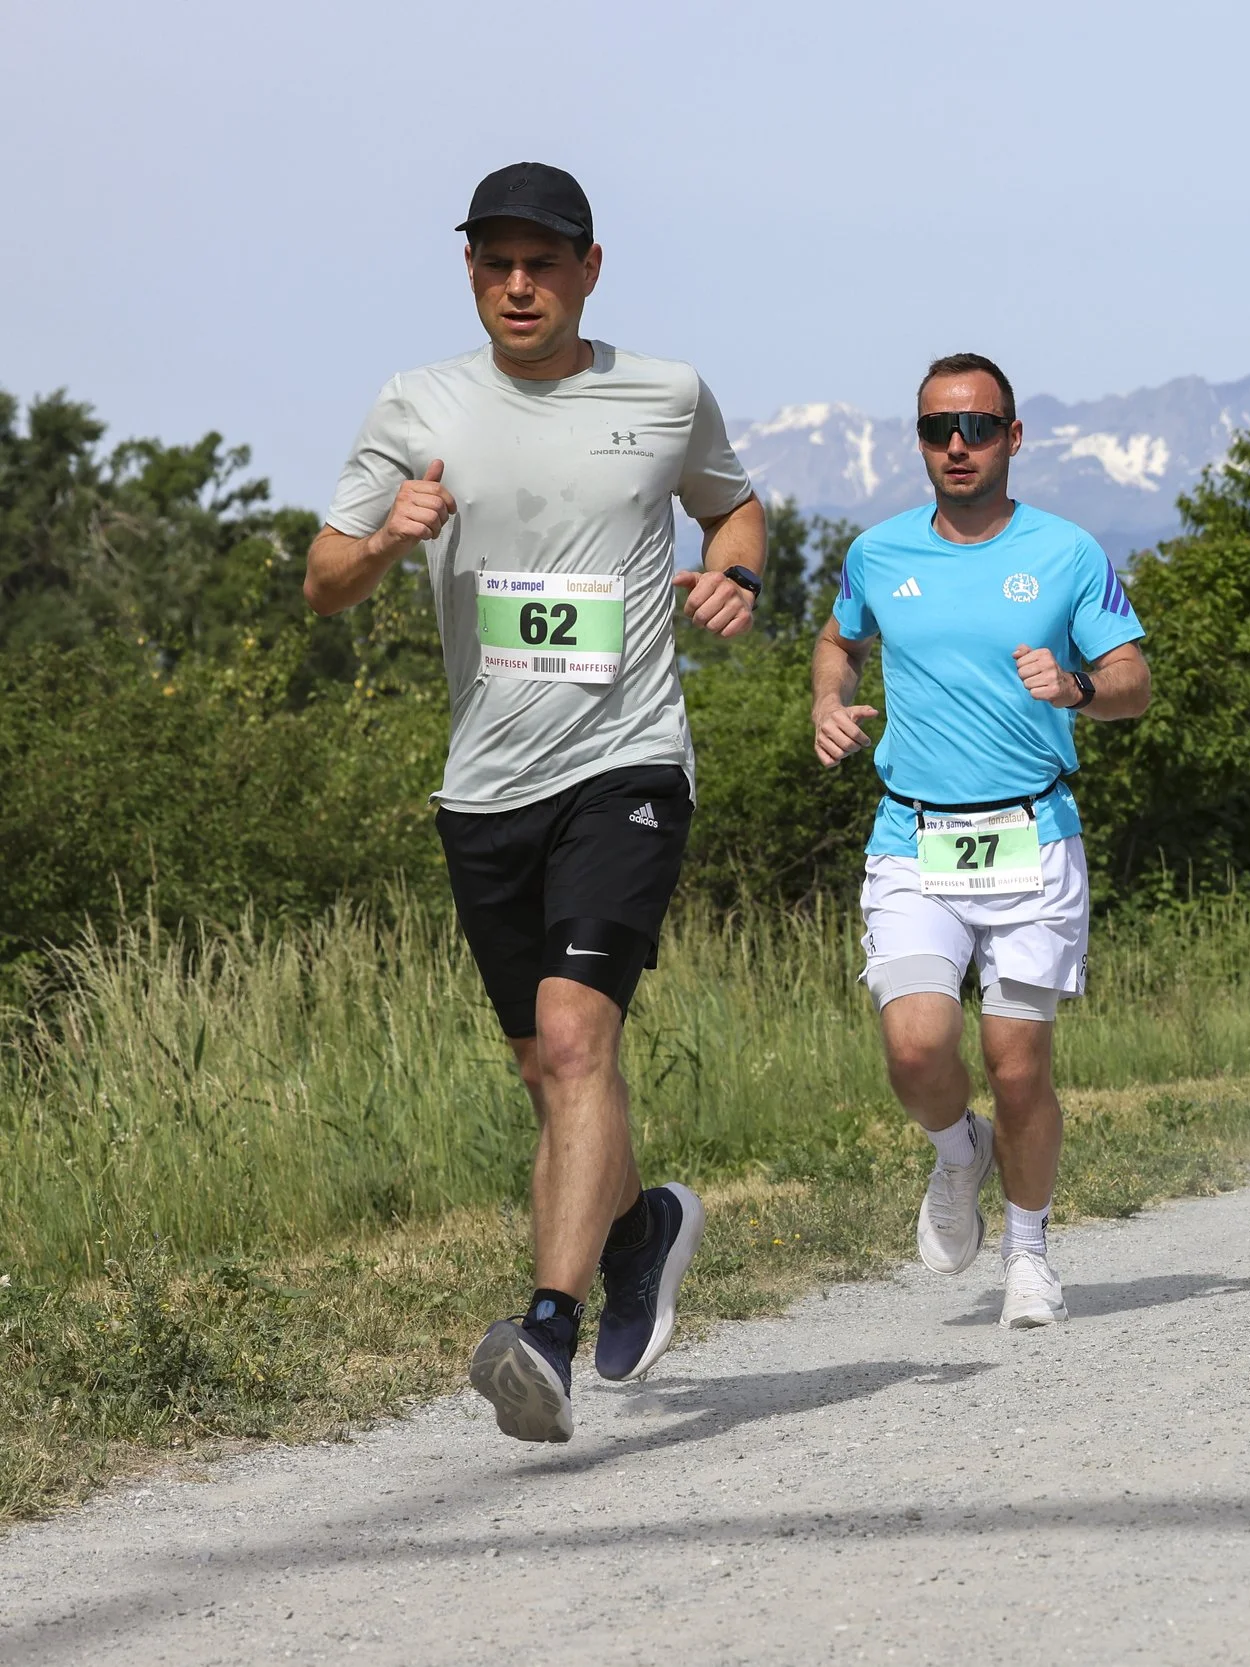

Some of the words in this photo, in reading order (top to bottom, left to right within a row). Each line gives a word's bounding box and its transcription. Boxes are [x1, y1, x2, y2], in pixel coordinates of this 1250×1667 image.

[622, 449, 654, 458] ARMOUR
[486, 579, 500, 589] stv
[511, 580, 545, 592] gampel
[566, 579, 613, 593] lonzalauf
[519, 602, 578, 645] 62
[485, 656, 528, 669] RAIFFEISEN
[569, 663, 617, 673] RAIFFEISEN
[629, 814, 658, 828] adidas
[926, 820, 937, 829] stv
[946, 819, 973, 830] gampel
[988, 812, 1025, 826] lonzalauf
[955, 834, 1000, 870] 27
[998, 875, 1039, 885] RAIFFEISEN
